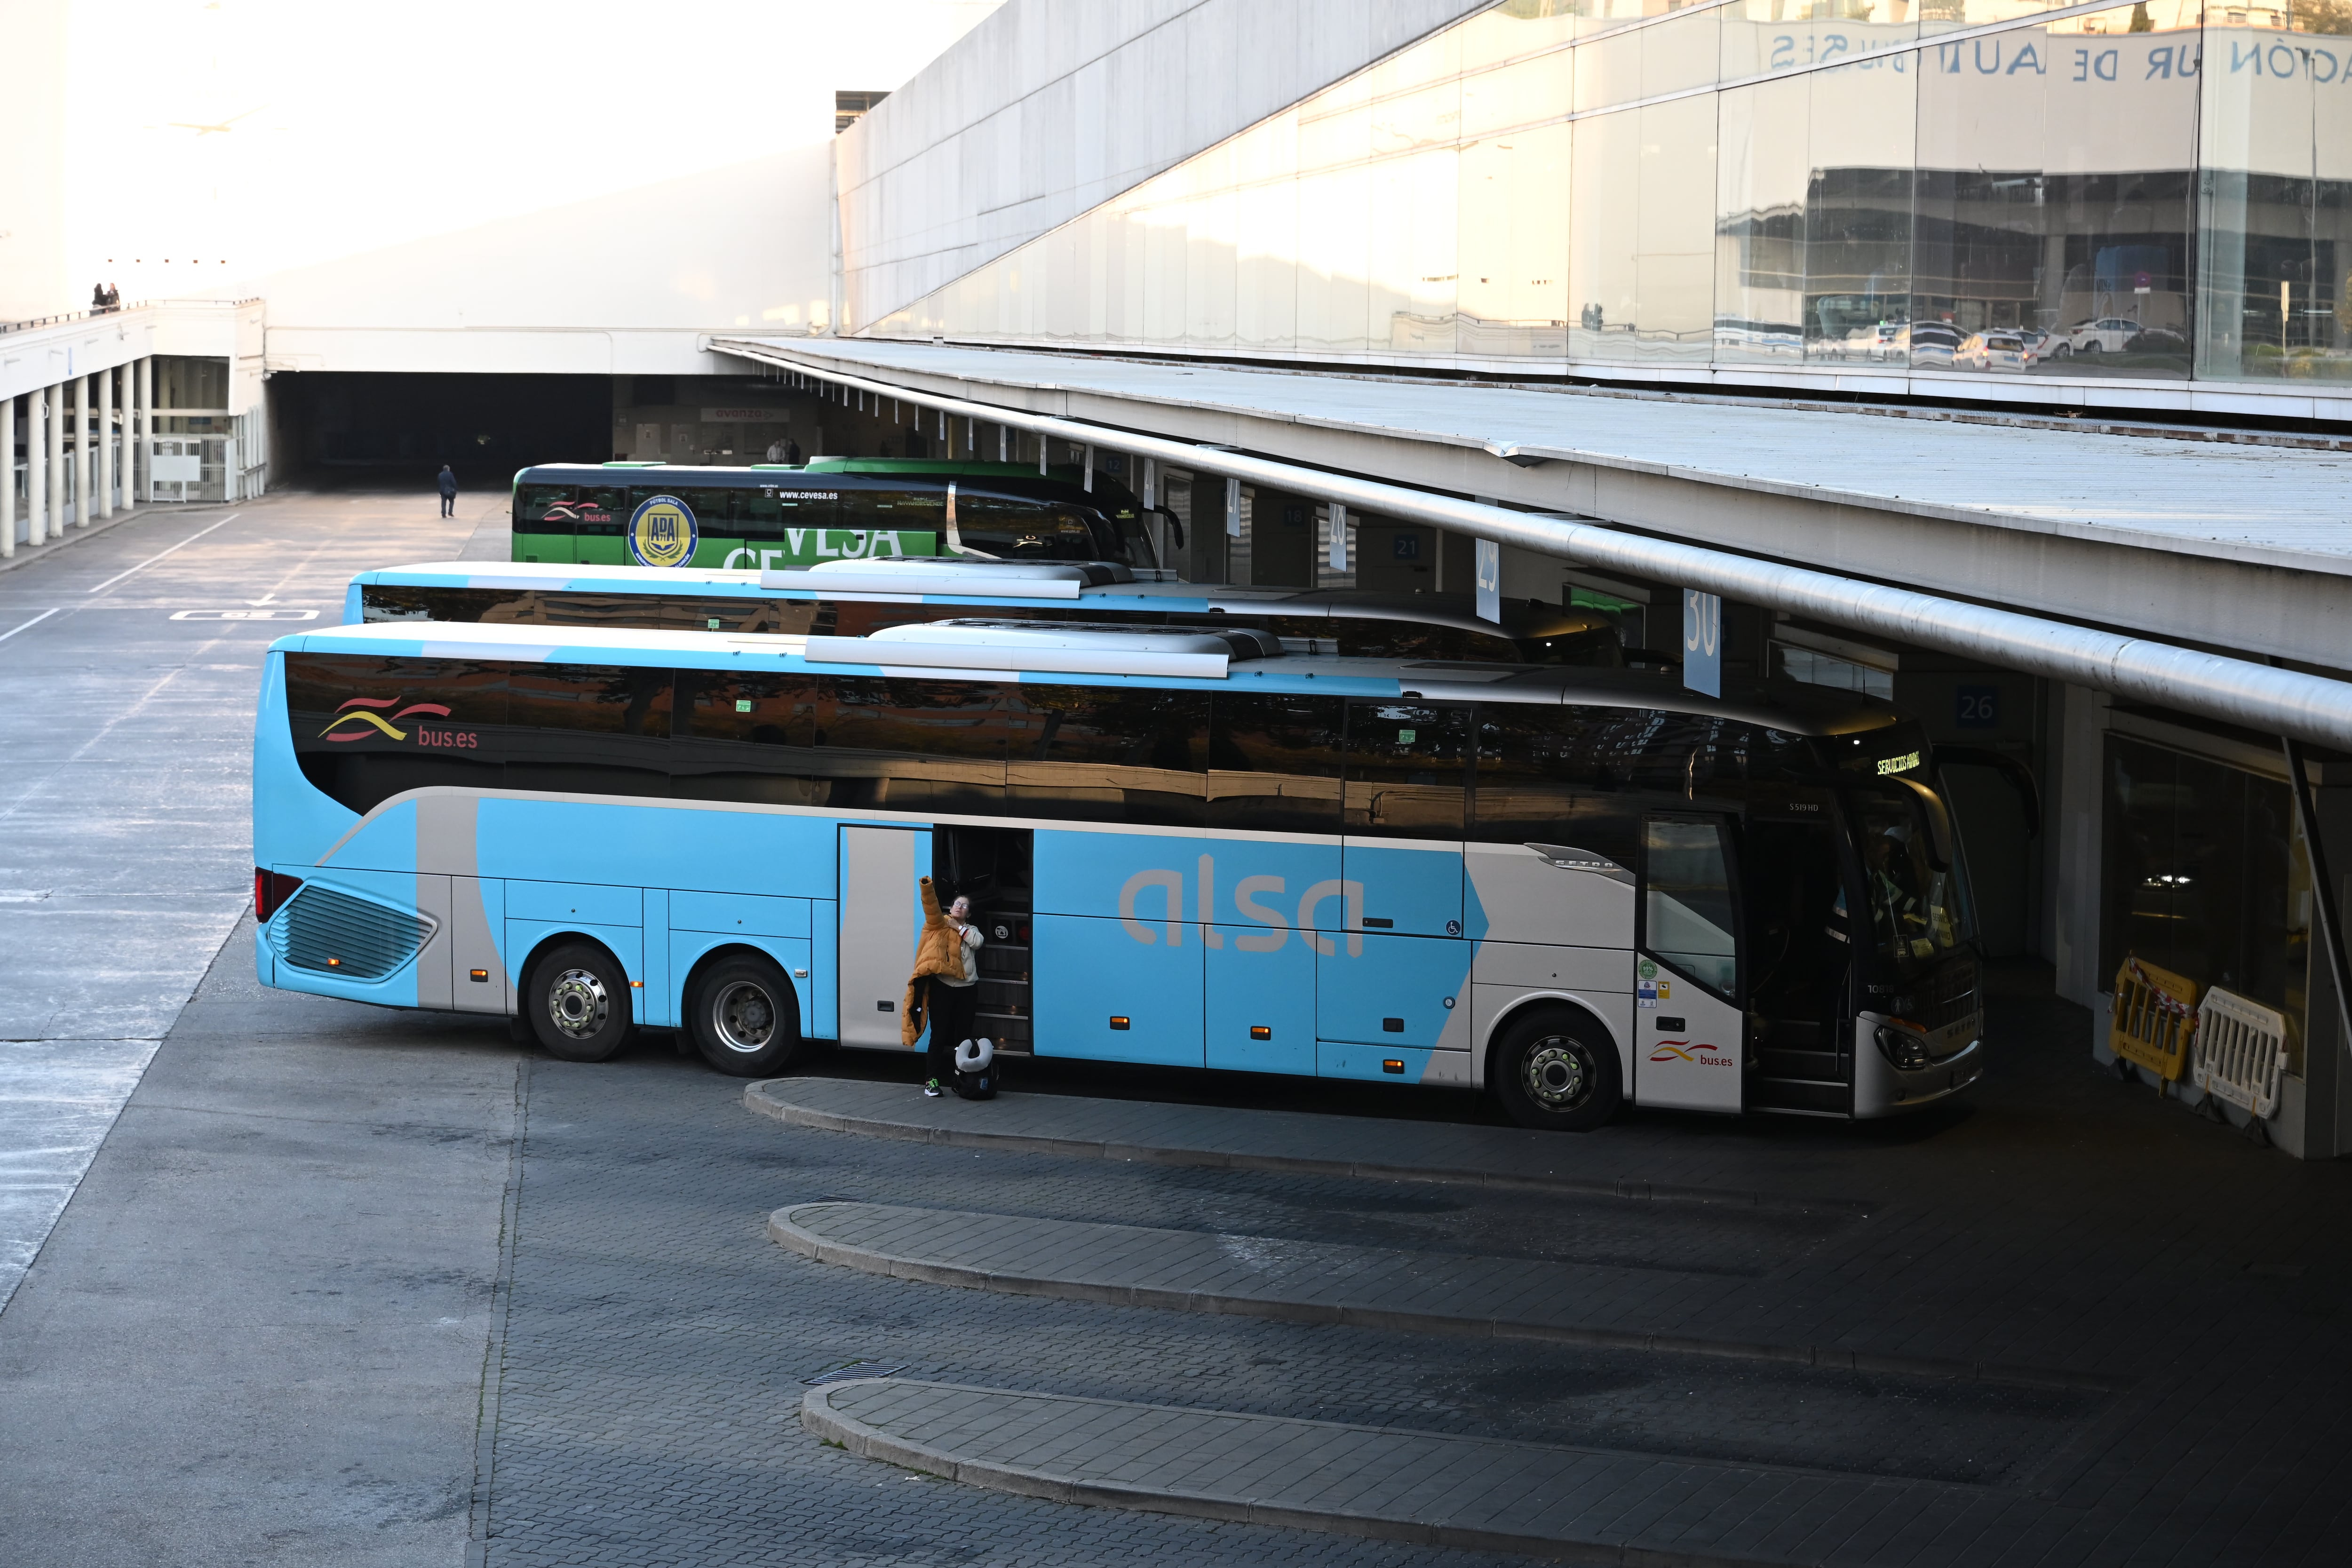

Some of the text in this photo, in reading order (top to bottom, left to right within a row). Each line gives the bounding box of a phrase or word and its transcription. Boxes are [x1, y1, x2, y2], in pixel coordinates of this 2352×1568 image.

[715, 409, 762, 418] avanza
[1108, 460, 1120, 470] 12
[650, 497, 667, 506] FÚTBOL
[779, 491, 838, 500] www.cevesa.es
[584, 512, 611, 522] bus.es
[1287, 510, 1302, 523] 18
[651, 517, 675, 541] ADA
[1331, 504, 1344, 546] 28
[1398, 540, 1415, 555] 21
[1478, 540, 1497, 592] 29
[1687, 590, 1716, 656] 30
[1961, 695, 1993, 719] 26
[419, 725, 477, 748] bus.es
[1877, 755, 1907, 775] SERVICIOS
[1119, 853, 1364, 958] alsa
[1867, 985, 1894, 993] 10818
[1700, 1054, 1732, 1067] bus.es
